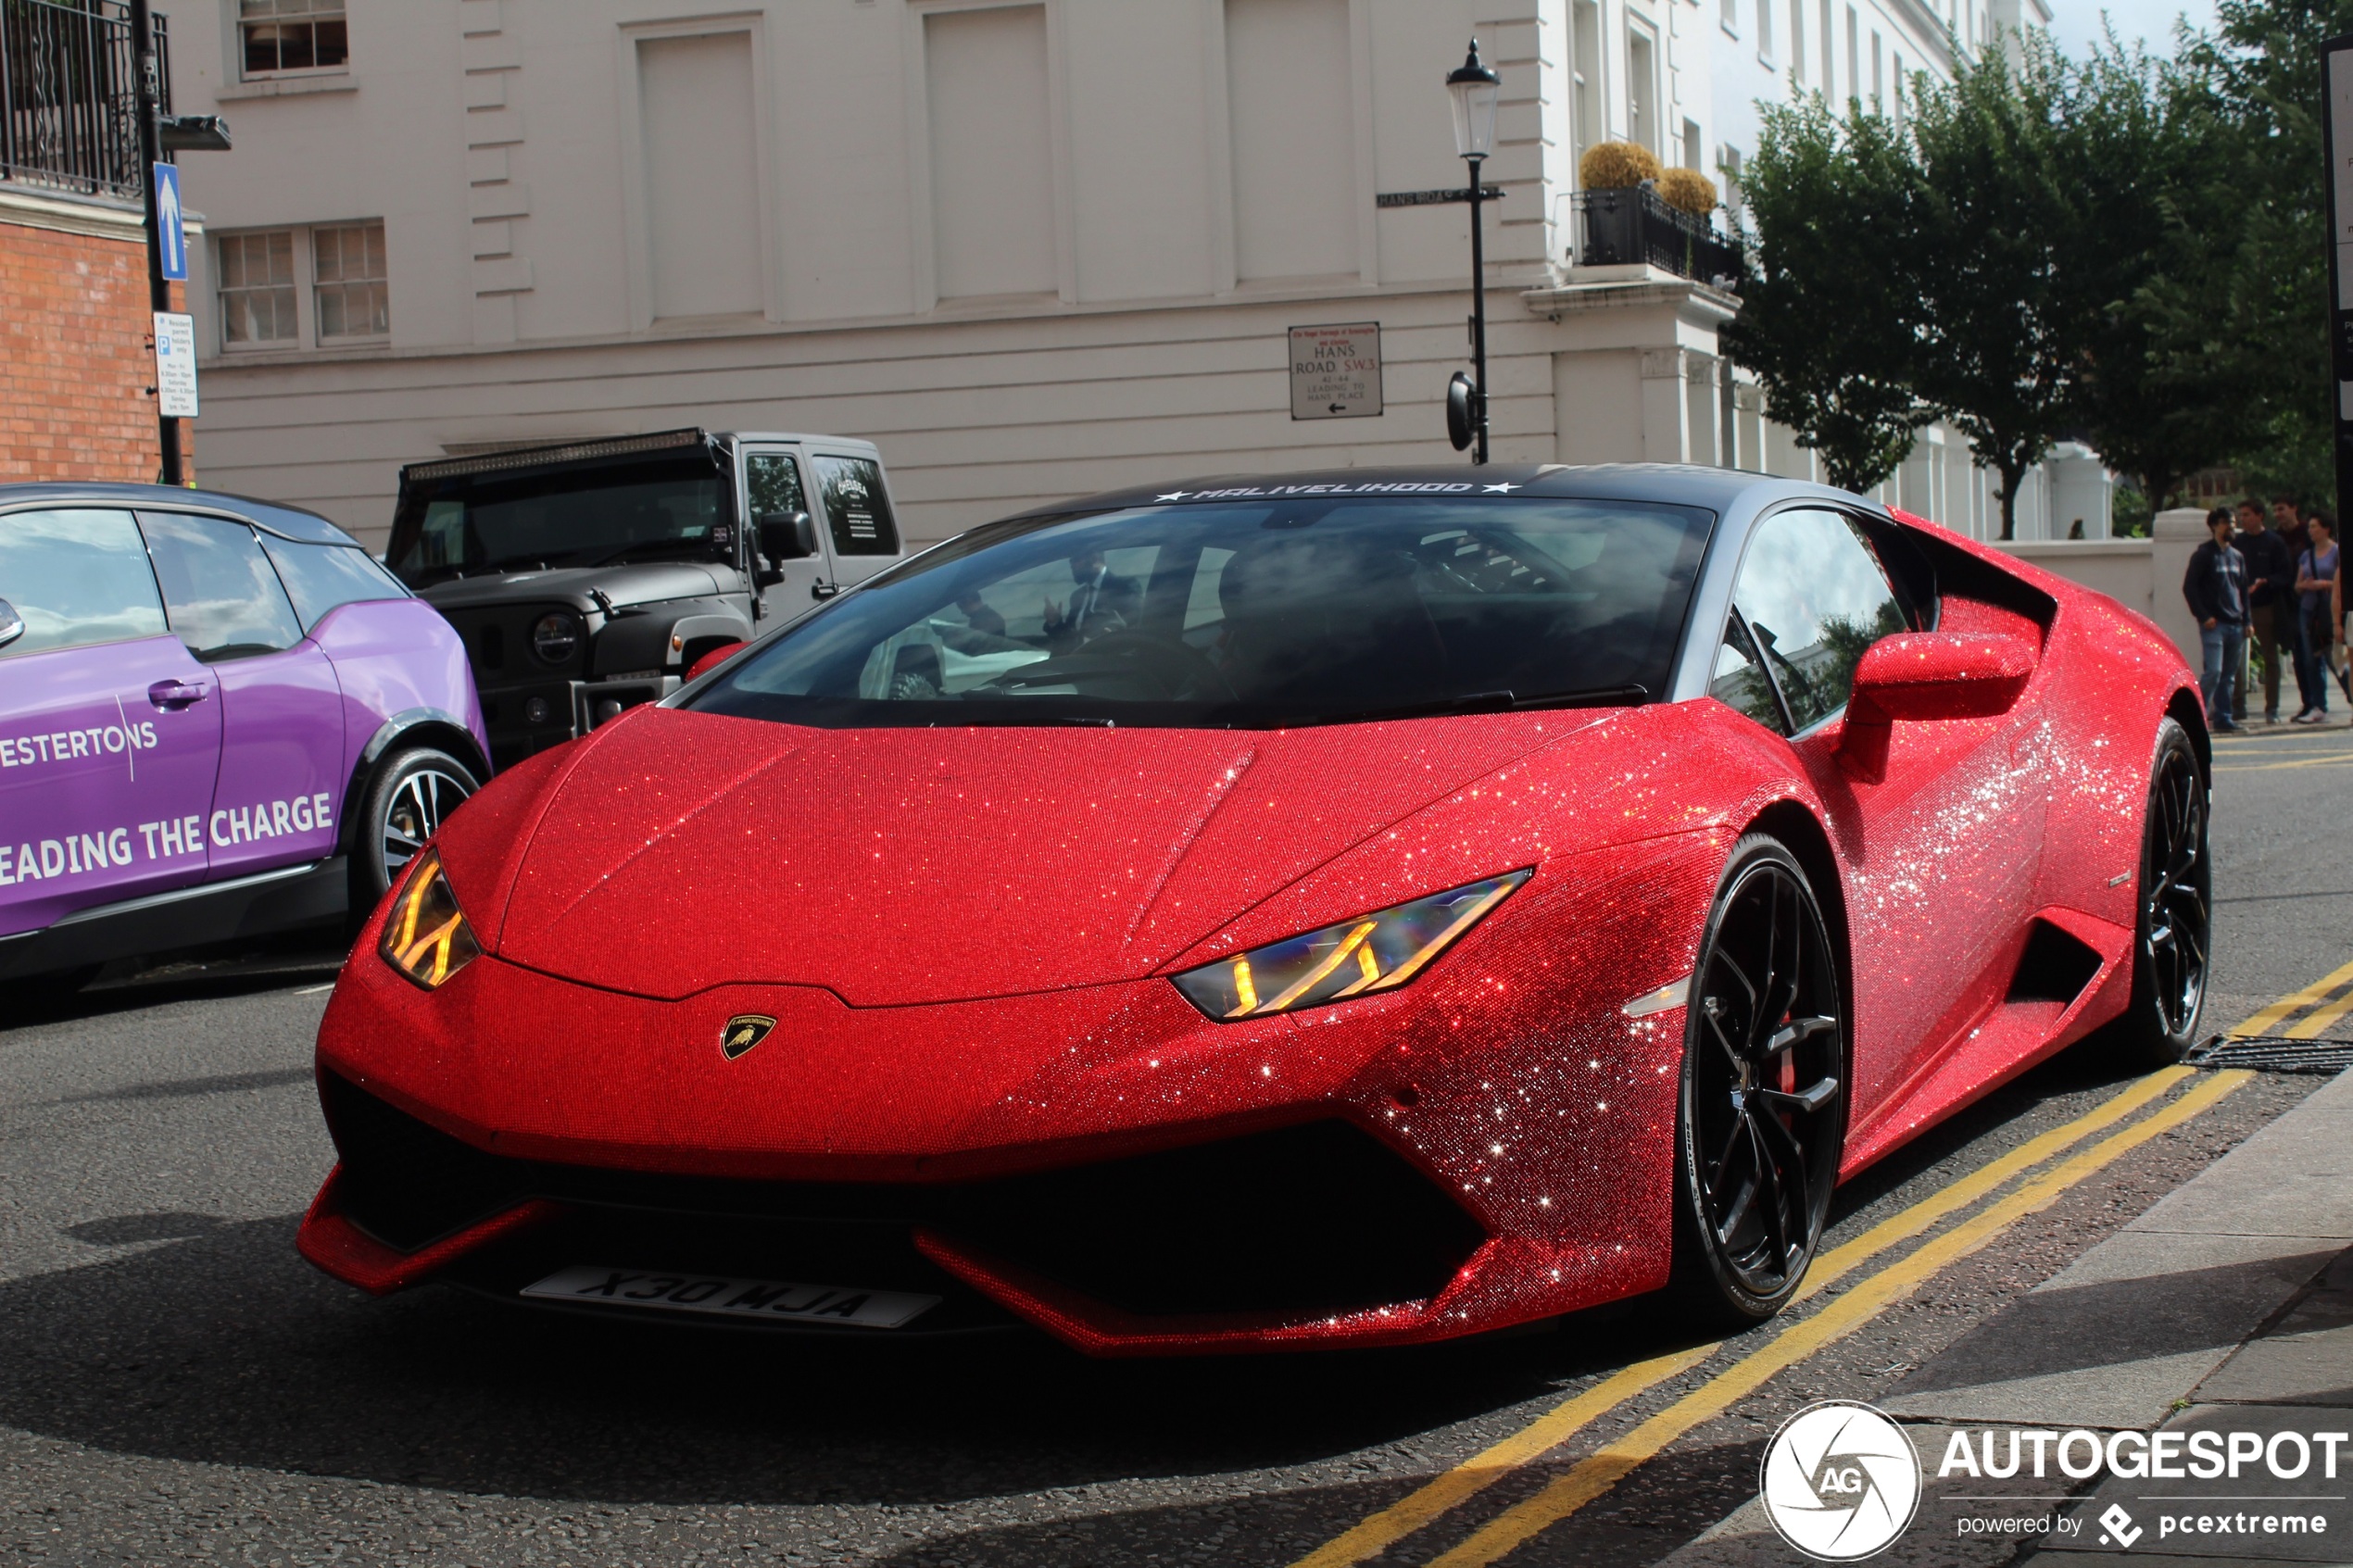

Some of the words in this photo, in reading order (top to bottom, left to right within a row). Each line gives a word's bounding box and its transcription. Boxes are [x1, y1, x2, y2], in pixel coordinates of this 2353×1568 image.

[1378, 193, 1414, 206] HANS
[1315, 345, 1356, 358] HANS
[1296, 360, 1337, 374] ROAD
[1307, 383, 1347, 394] LEADING
[1353, 382, 1365, 391] TO
[1307, 393, 1331, 401] HANS
[1338, 391, 1364, 400] PLACE
[837, 478, 869, 498] CHELSEA
[1192, 483, 1473, 498] MALIVELIHOOD
[0, 721, 157, 768] ESTERTONS
[0, 827, 133, 886] EADING
[139, 815, 204, 859] THE
[209, 793, 333, 847] CHARGE
[576, 1272, 721, 1303] X30
[725, 1285, 874, 1318] MJA
